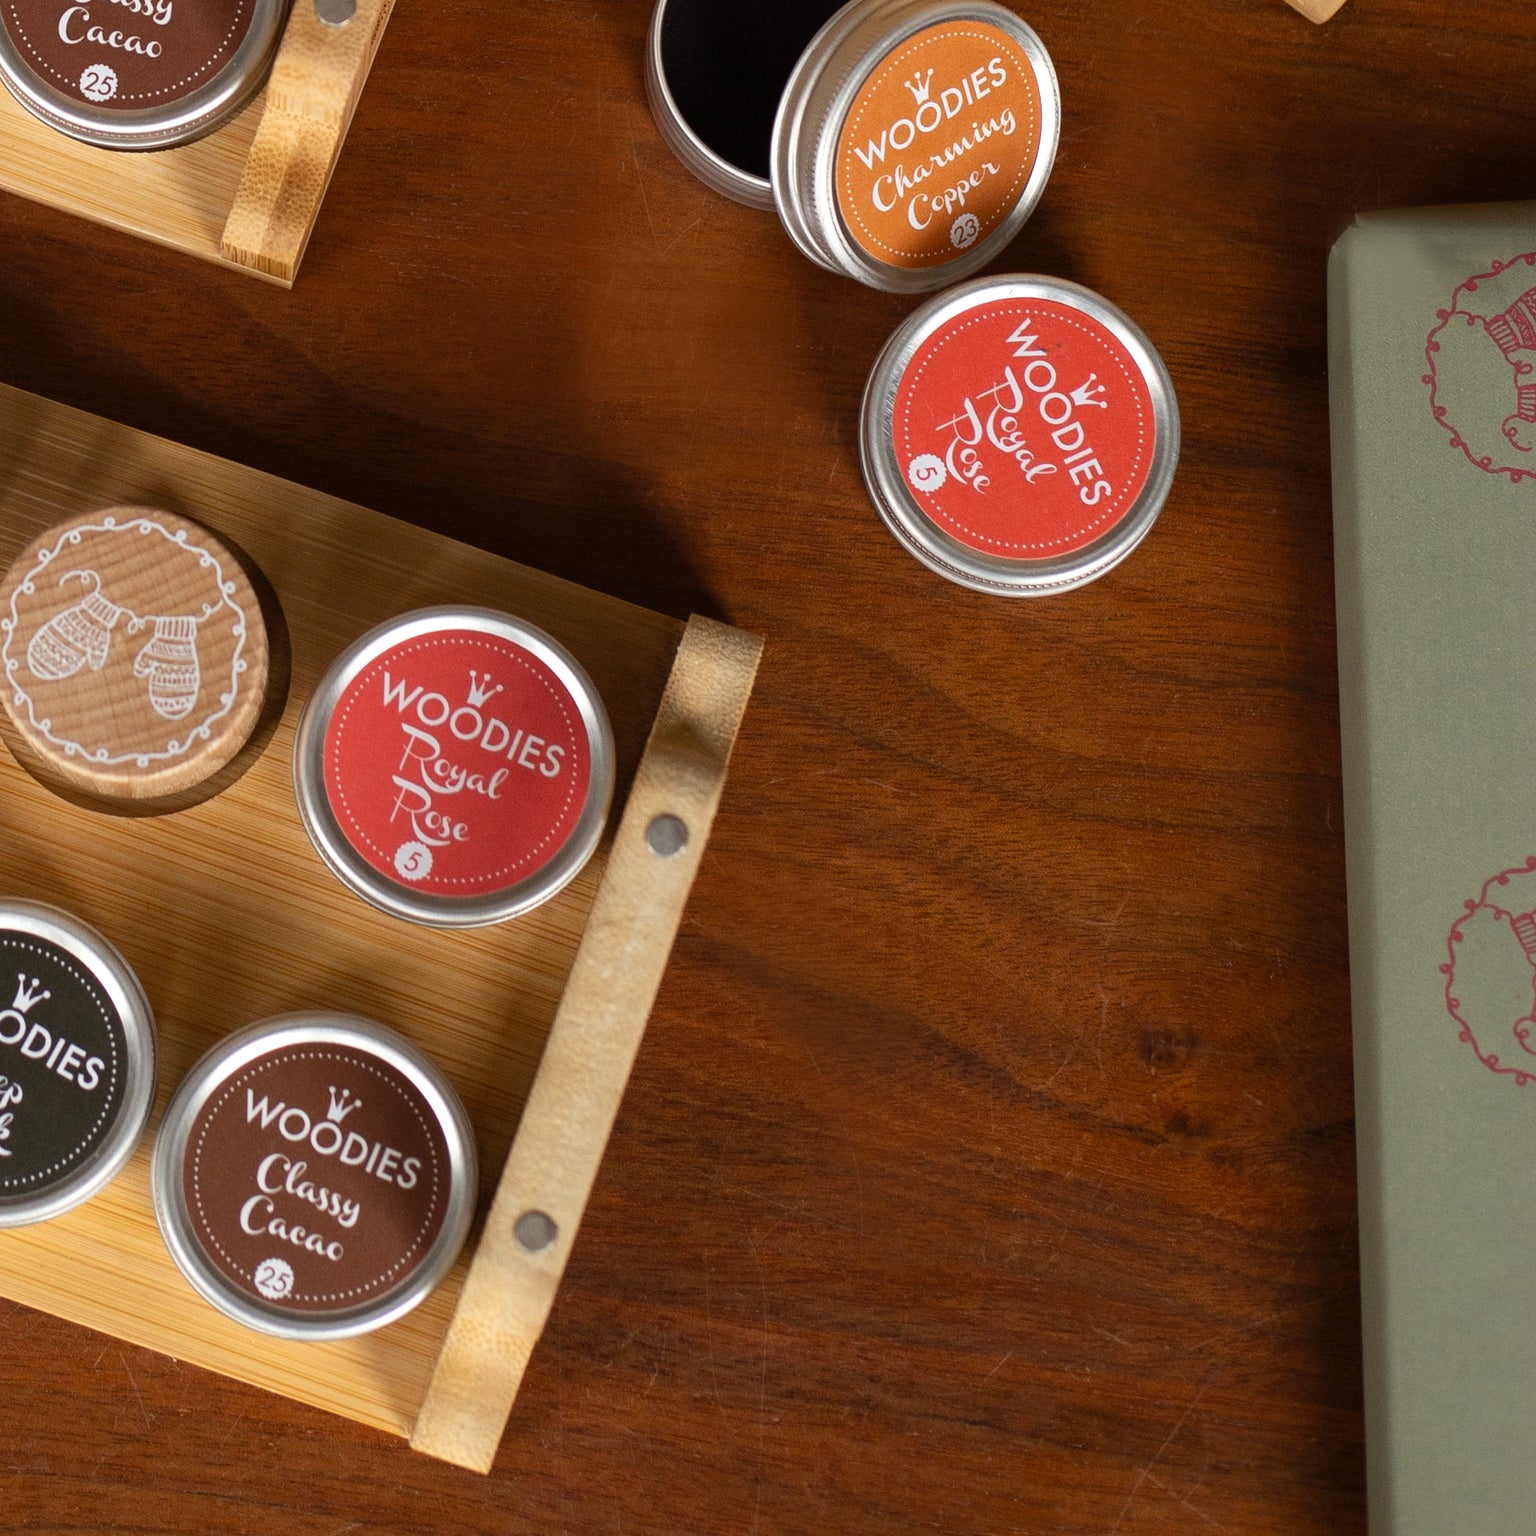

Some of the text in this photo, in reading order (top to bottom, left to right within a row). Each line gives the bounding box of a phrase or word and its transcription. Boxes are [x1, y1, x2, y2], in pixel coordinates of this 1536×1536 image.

[58, 6, 163, 58] Cacao
[84, 71, 115, 95] 25
[854, 56, 1007, 170] WOODIES
[872, 107, 1016, 212] Charming
[907, 162, 1000, 230] Copper
[953, 218, 977, 246] 23
[935, 397, 991, 495] Rose
[976, 365, 1058, 485] Royal
[1005, 317, 1112, 506] WOODIES
[916, 465, 939, 482] 5
[383, 671, 565, 778] WOODIES
[399, 722, 509, 800] Royal
[390, 774, 470, 846] Rose
[403, 851, 423, 872] 5
[246, 1087, 422, 1189] WOODIES
[256, 1153, 360, 1228] Classy
[239, 1194, 344, 1261] Cacao
[258, 1265, 292, 1293] 25
